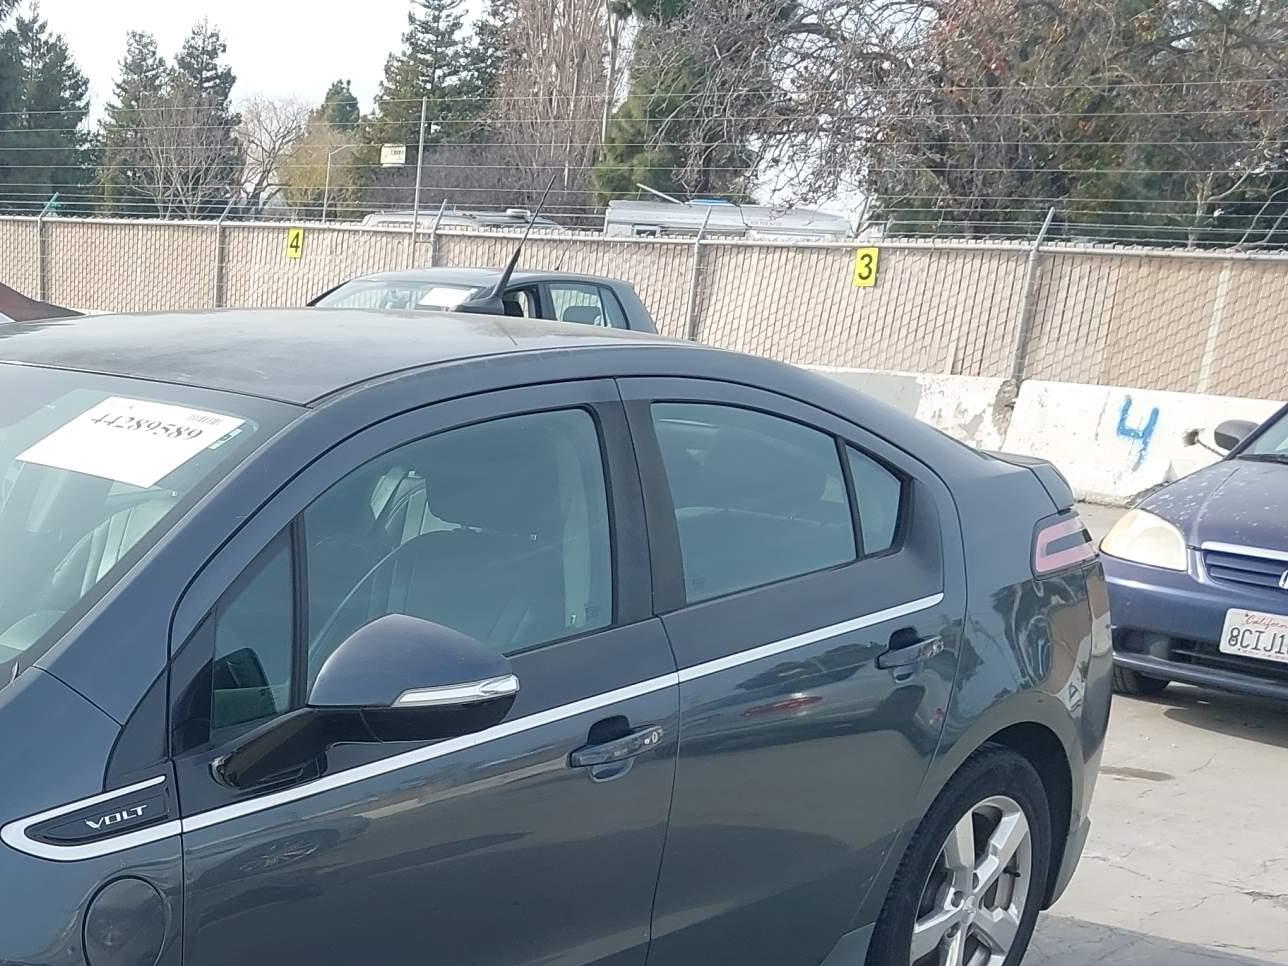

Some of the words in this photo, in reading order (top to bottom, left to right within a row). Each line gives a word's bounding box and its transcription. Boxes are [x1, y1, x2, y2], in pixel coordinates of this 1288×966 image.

[289, 231, 301, 253] 4
[858, 253, 873, 280] 3
[91, 413, 204, 440] 44289589
[1117, 394, 1160, 472] 4
[1228, 627, 1288, 655] 8CIJ1
[84, 804, 148, 831] VOLT
